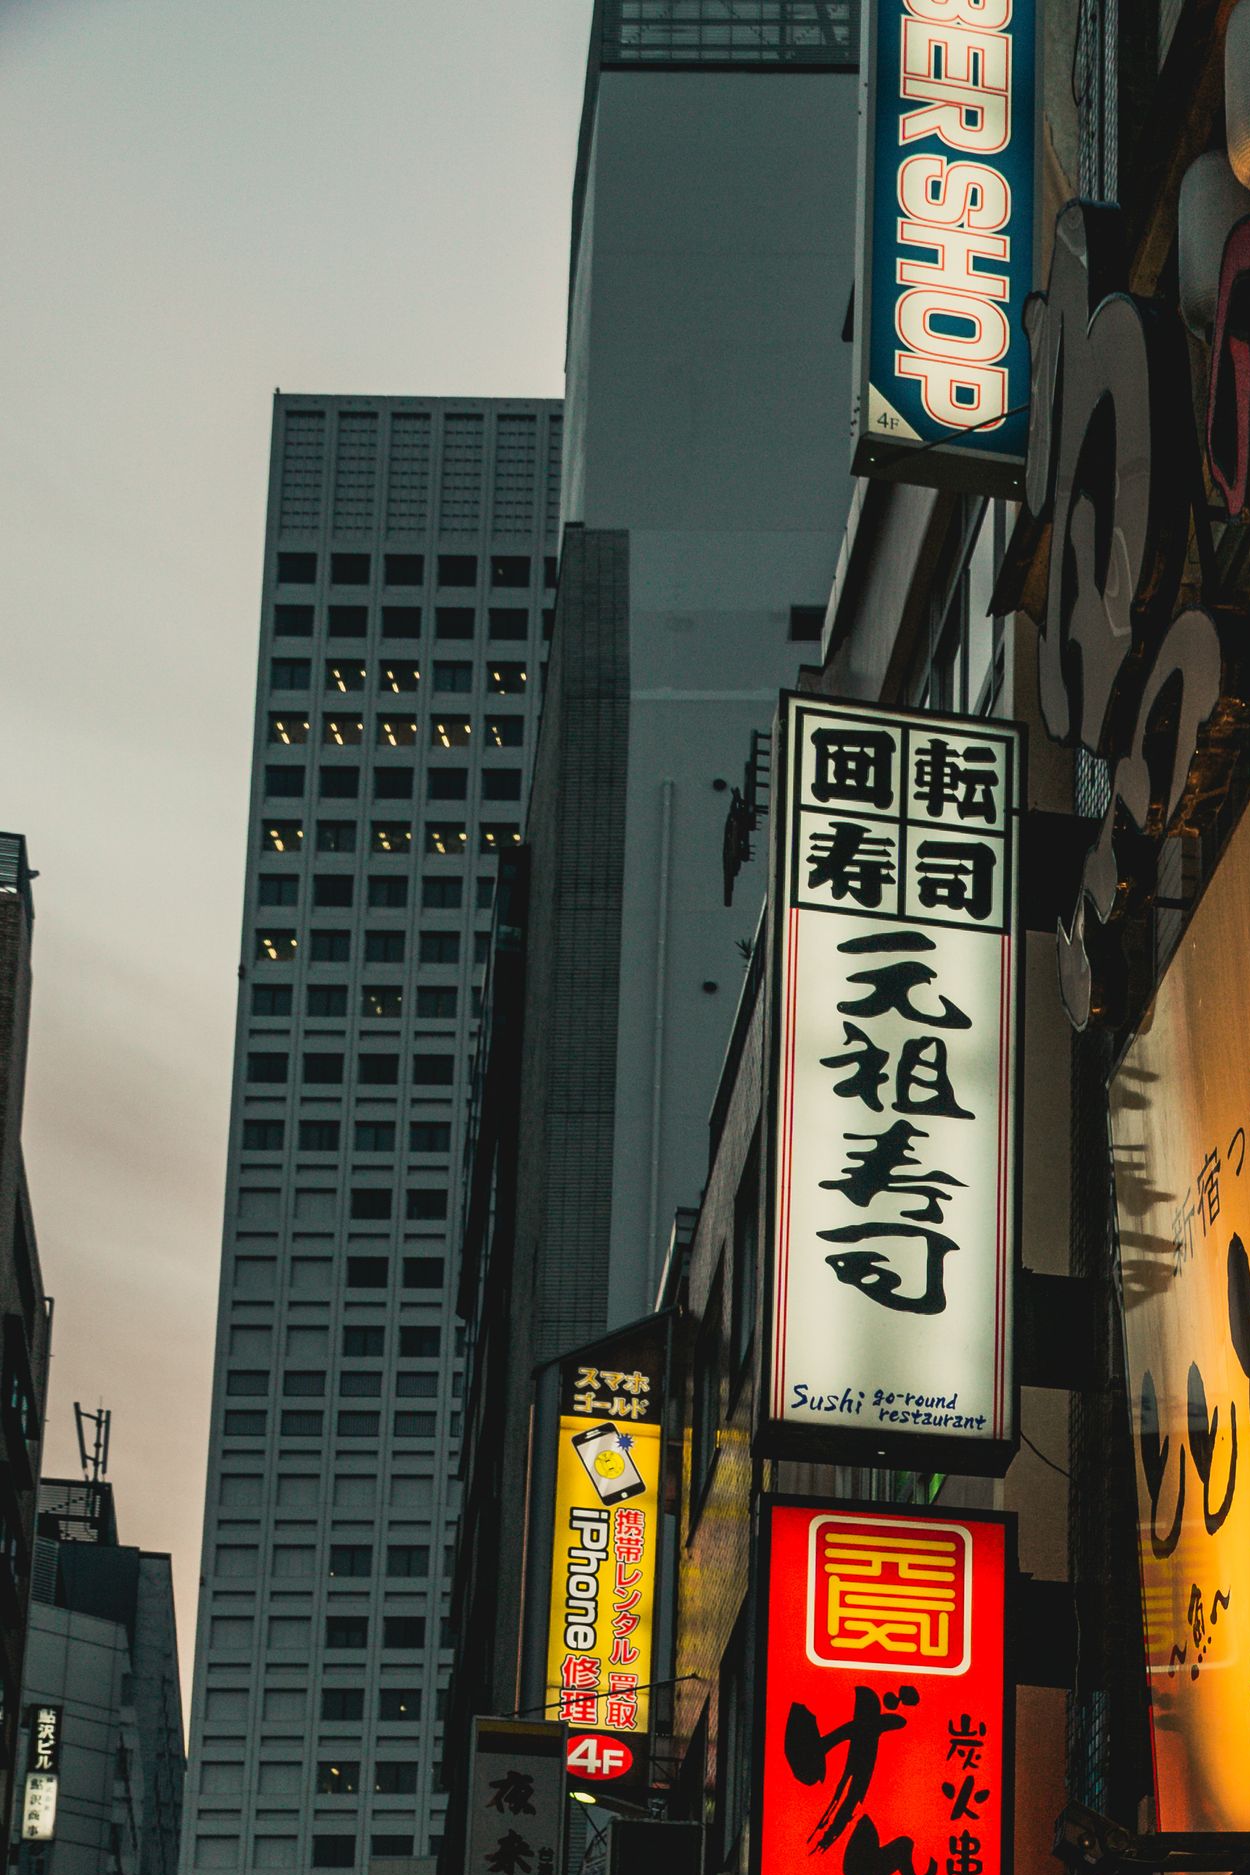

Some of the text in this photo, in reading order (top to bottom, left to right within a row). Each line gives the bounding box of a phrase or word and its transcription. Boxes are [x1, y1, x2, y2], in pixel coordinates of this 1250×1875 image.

[894, 153, 1012, 433] SHOP
[876, 412, 900, 432] 4F
[811, 727, 999, 824] 回転
[806, 822, 997, 921] 寿司
[816, 931, 975, 1315] 元祖寿司
[572, 1392, 649, 1419] ゴールド
[574, 1366, 651, 1394] スマホ
[790, 1384, 958, 1415] Sushi go-round
[878, 1407, 987, 1431] restaurant
[558, 1505, 611, 1725] iPhone 修理
[606, 1507, 645, 1730] 携帯レンタル 買取
[566, 1738, 624, 1776] 4F
